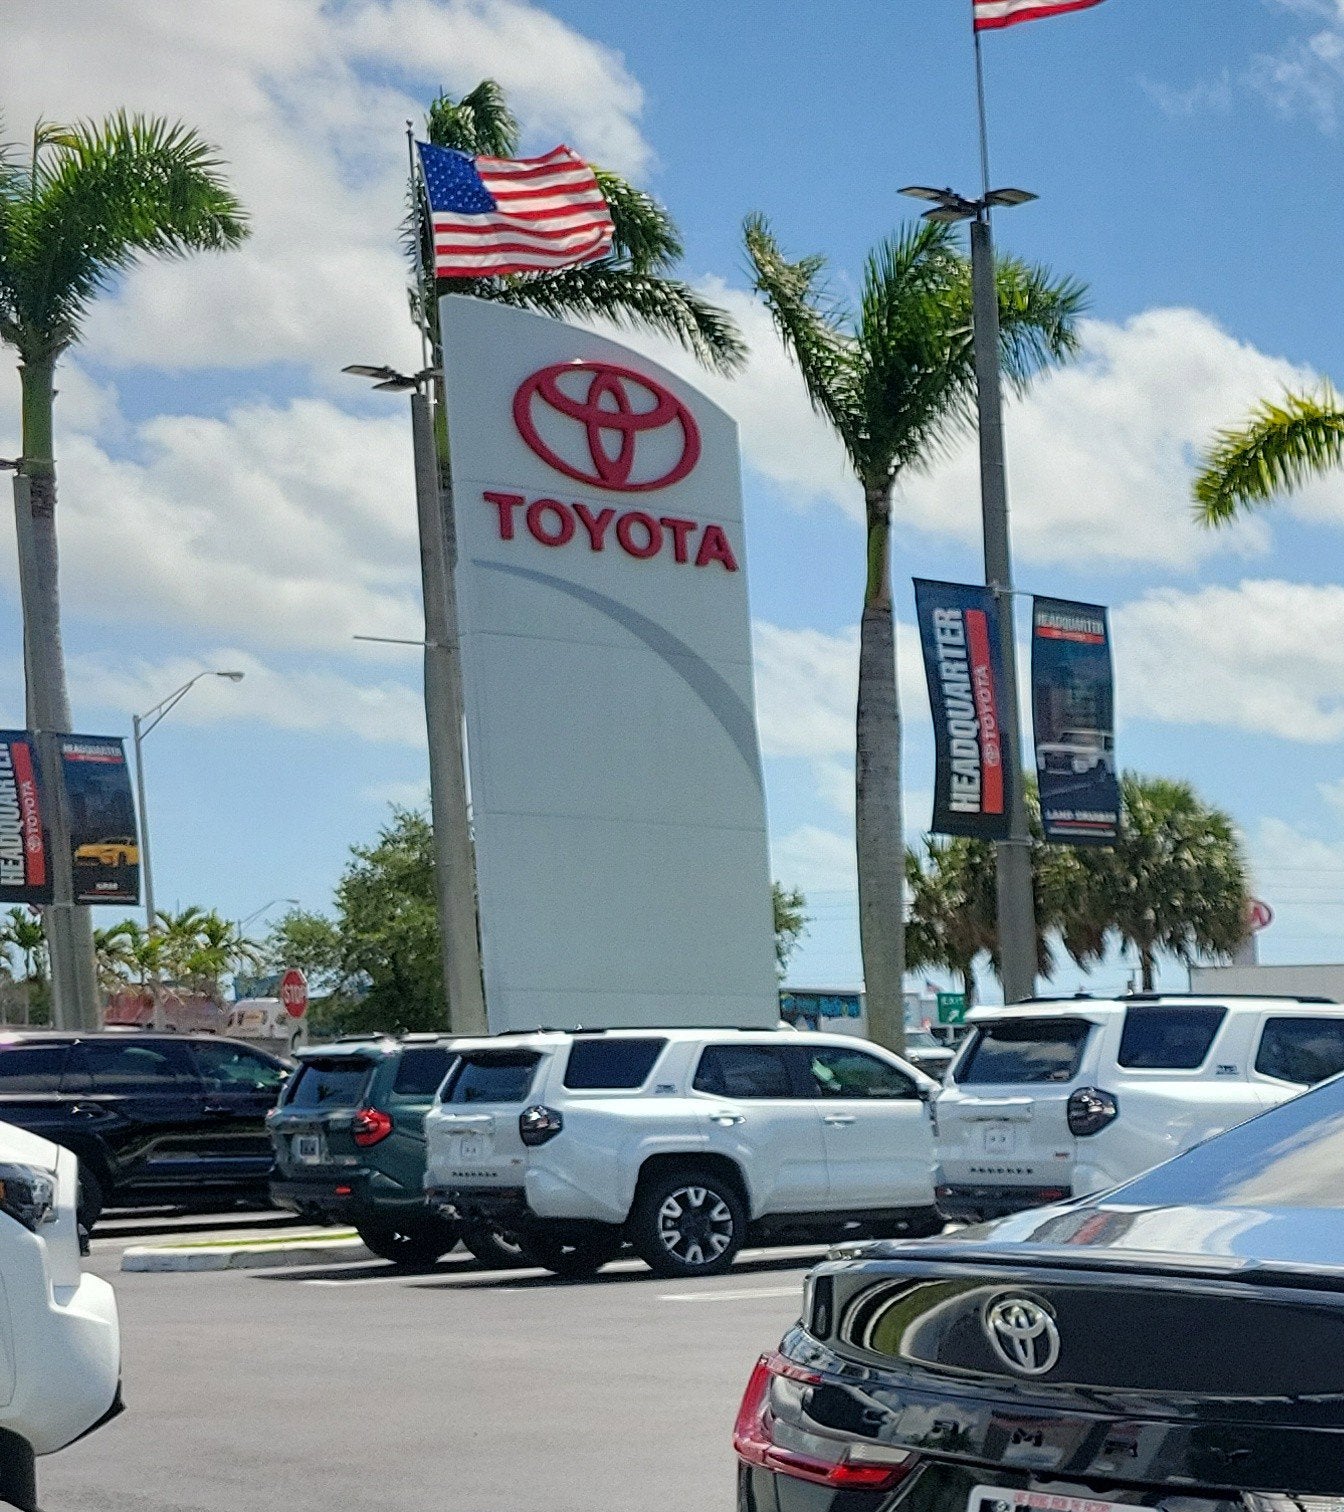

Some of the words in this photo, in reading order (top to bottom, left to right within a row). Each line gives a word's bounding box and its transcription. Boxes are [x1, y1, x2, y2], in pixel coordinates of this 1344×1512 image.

[483, 491, 739, 572] TOYOTA
[932, 608, 981, 813] HEADQUARTER
[974, 665, 999, 746] TOYOTA
[22, 781, 42, 833] TOYOTA
